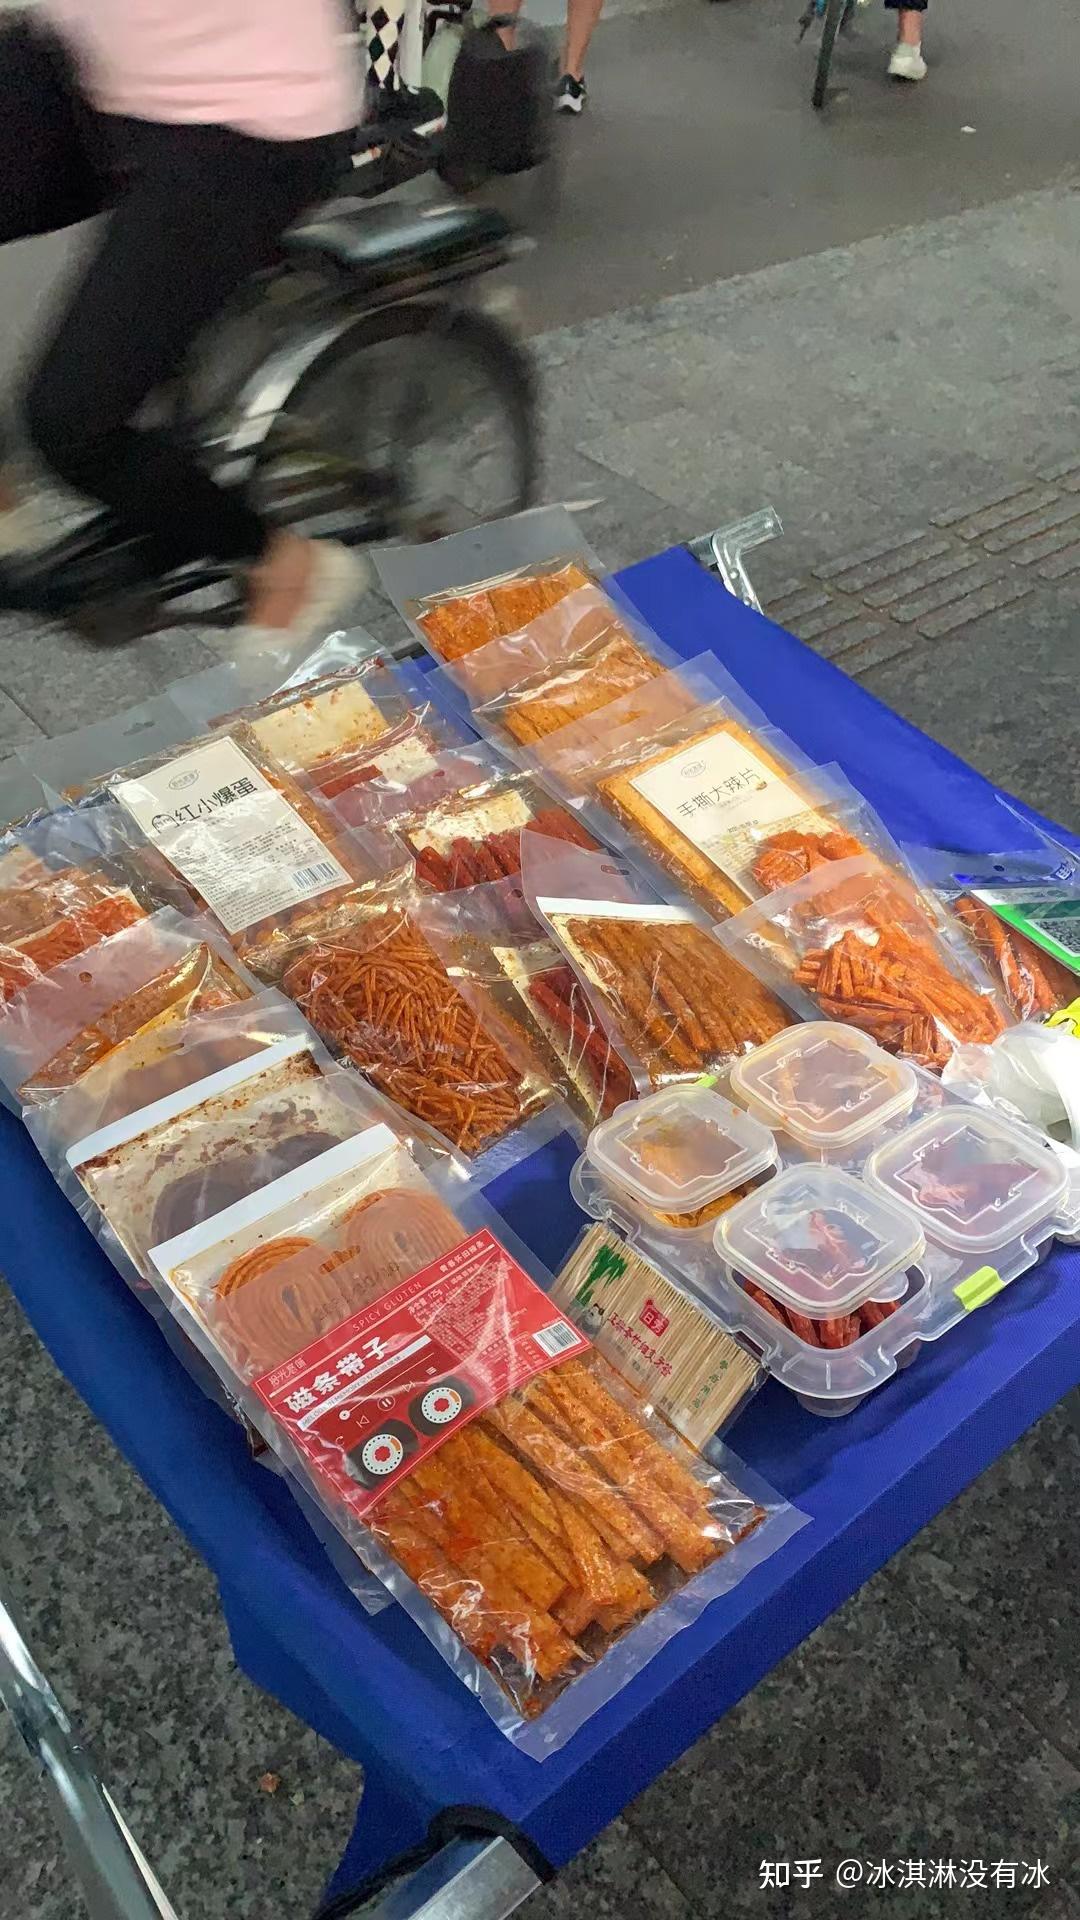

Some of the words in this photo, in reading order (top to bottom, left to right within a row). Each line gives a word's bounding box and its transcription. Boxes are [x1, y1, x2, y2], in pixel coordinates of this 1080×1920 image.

[676, 767, 762, 817] 手撕大辣片
[352, 1309, 381, 1331] SPICY
[383, 1282, 422, 1311] GLUTEN
[283, 1336, 388, 1413] 磁条带子
